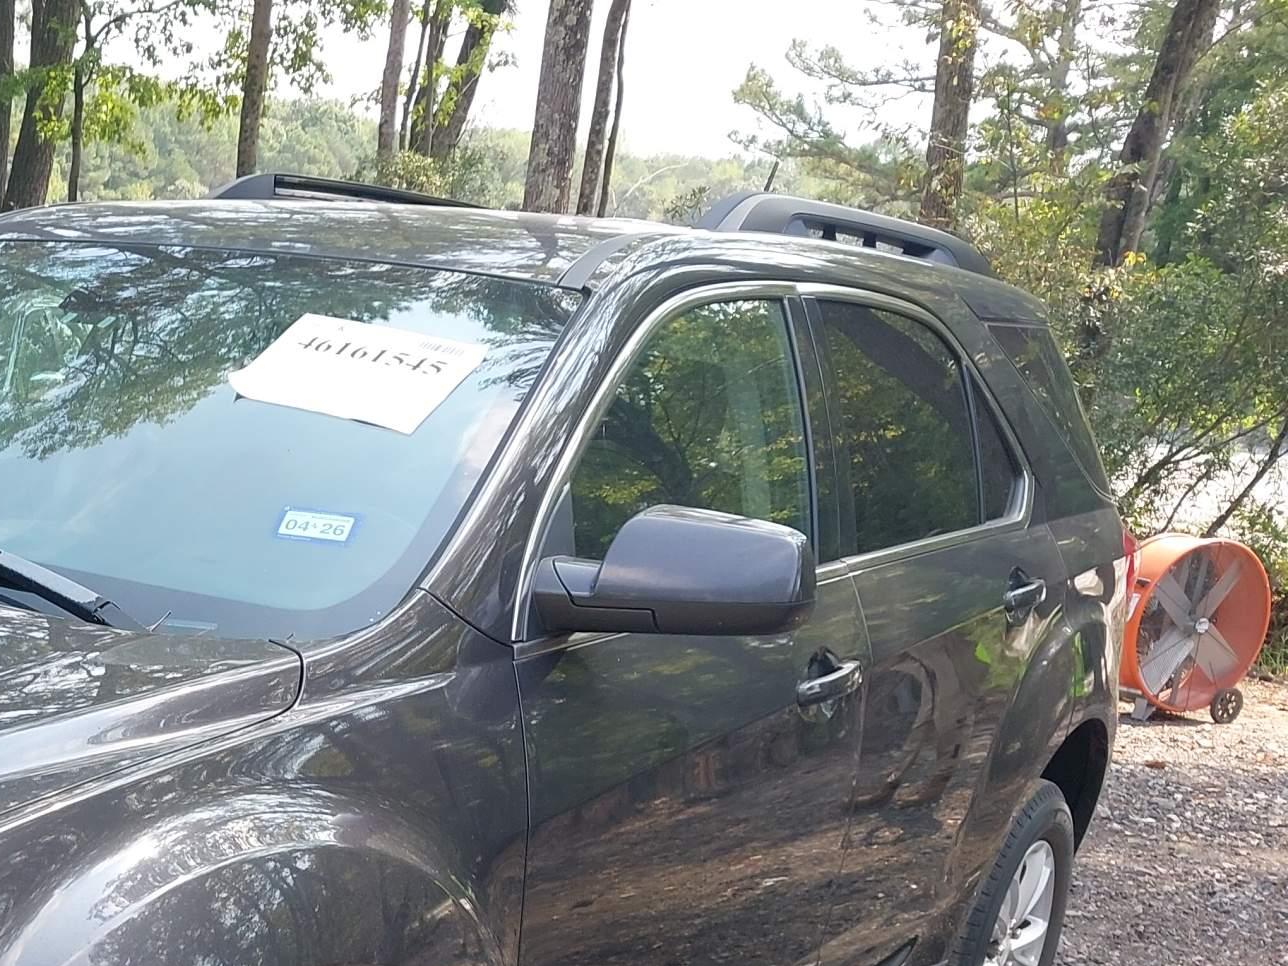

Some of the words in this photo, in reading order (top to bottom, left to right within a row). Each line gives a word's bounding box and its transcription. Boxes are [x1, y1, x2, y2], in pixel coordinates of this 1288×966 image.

[297, 336, 449, 375] 46161545
[285, 519, 310, 532] 04
[319, 523, 346, 536] 26
